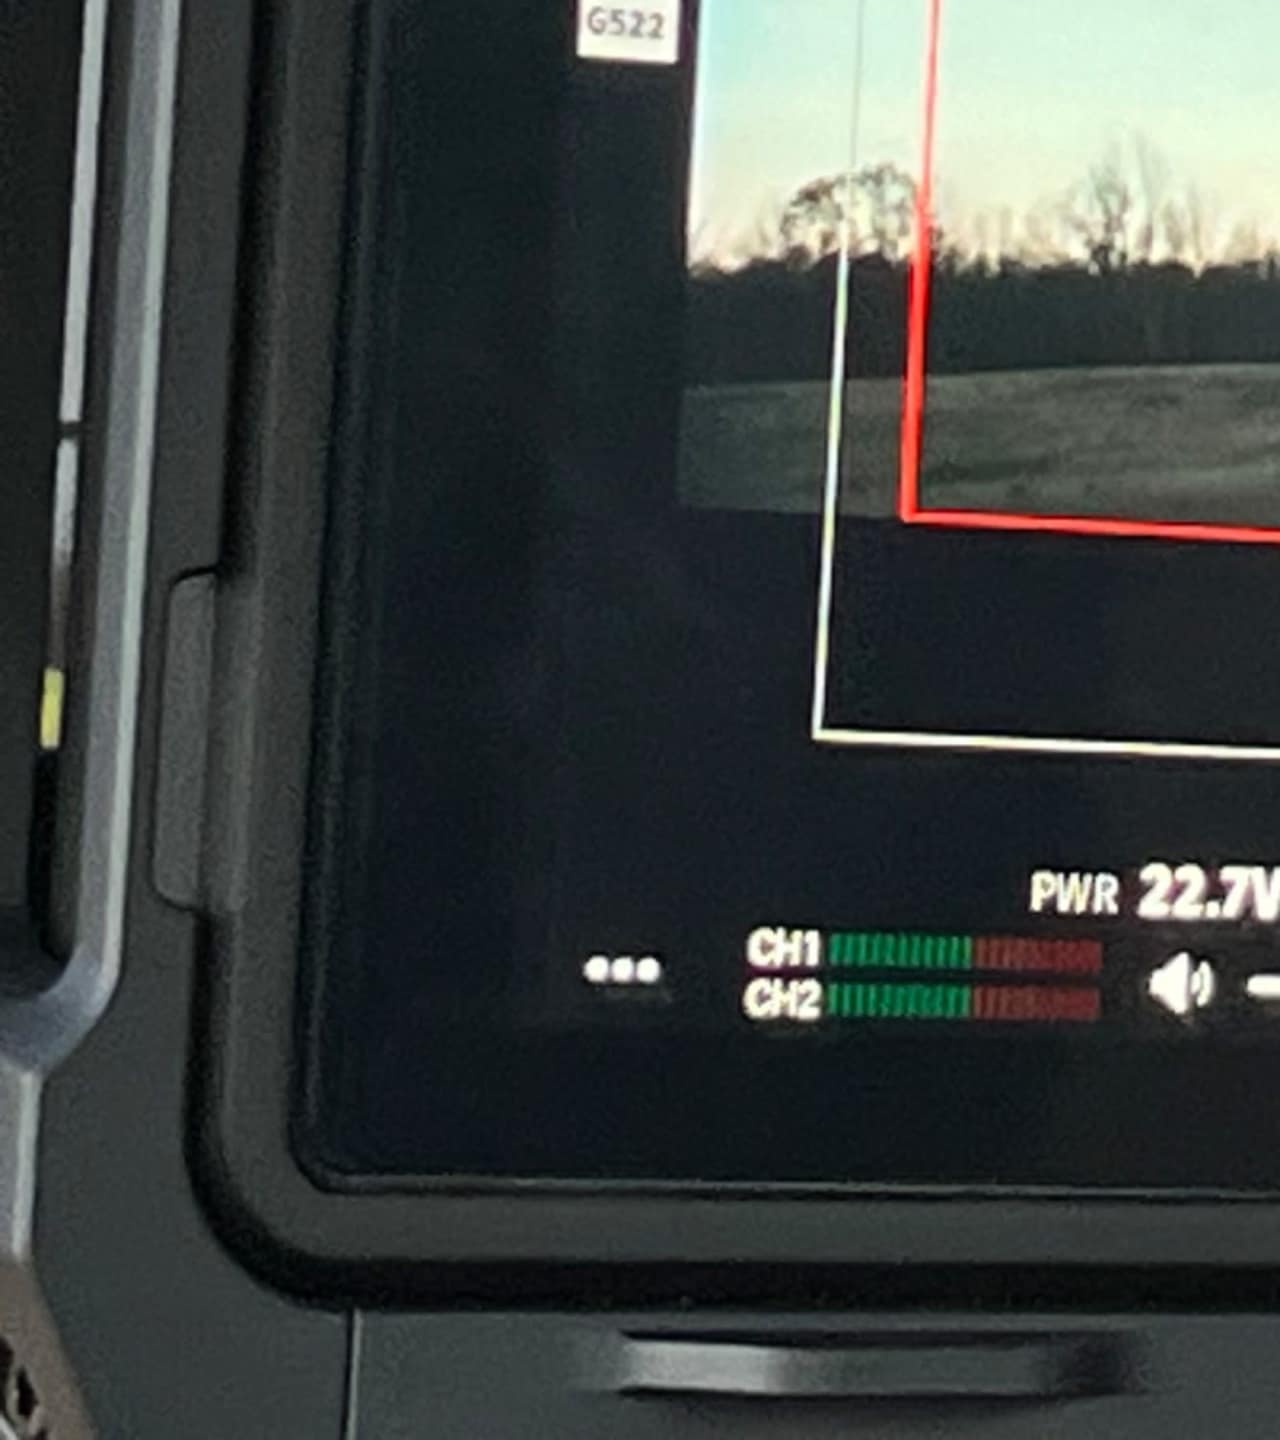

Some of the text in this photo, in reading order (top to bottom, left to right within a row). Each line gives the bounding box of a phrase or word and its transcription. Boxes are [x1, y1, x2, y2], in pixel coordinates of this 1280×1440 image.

[587, 6, 665, 40] G522
[1029, 870, 1119, 915] PWR
[745, 927, 821, 967] CH1
[743, 977, 823, 1021] CH2
